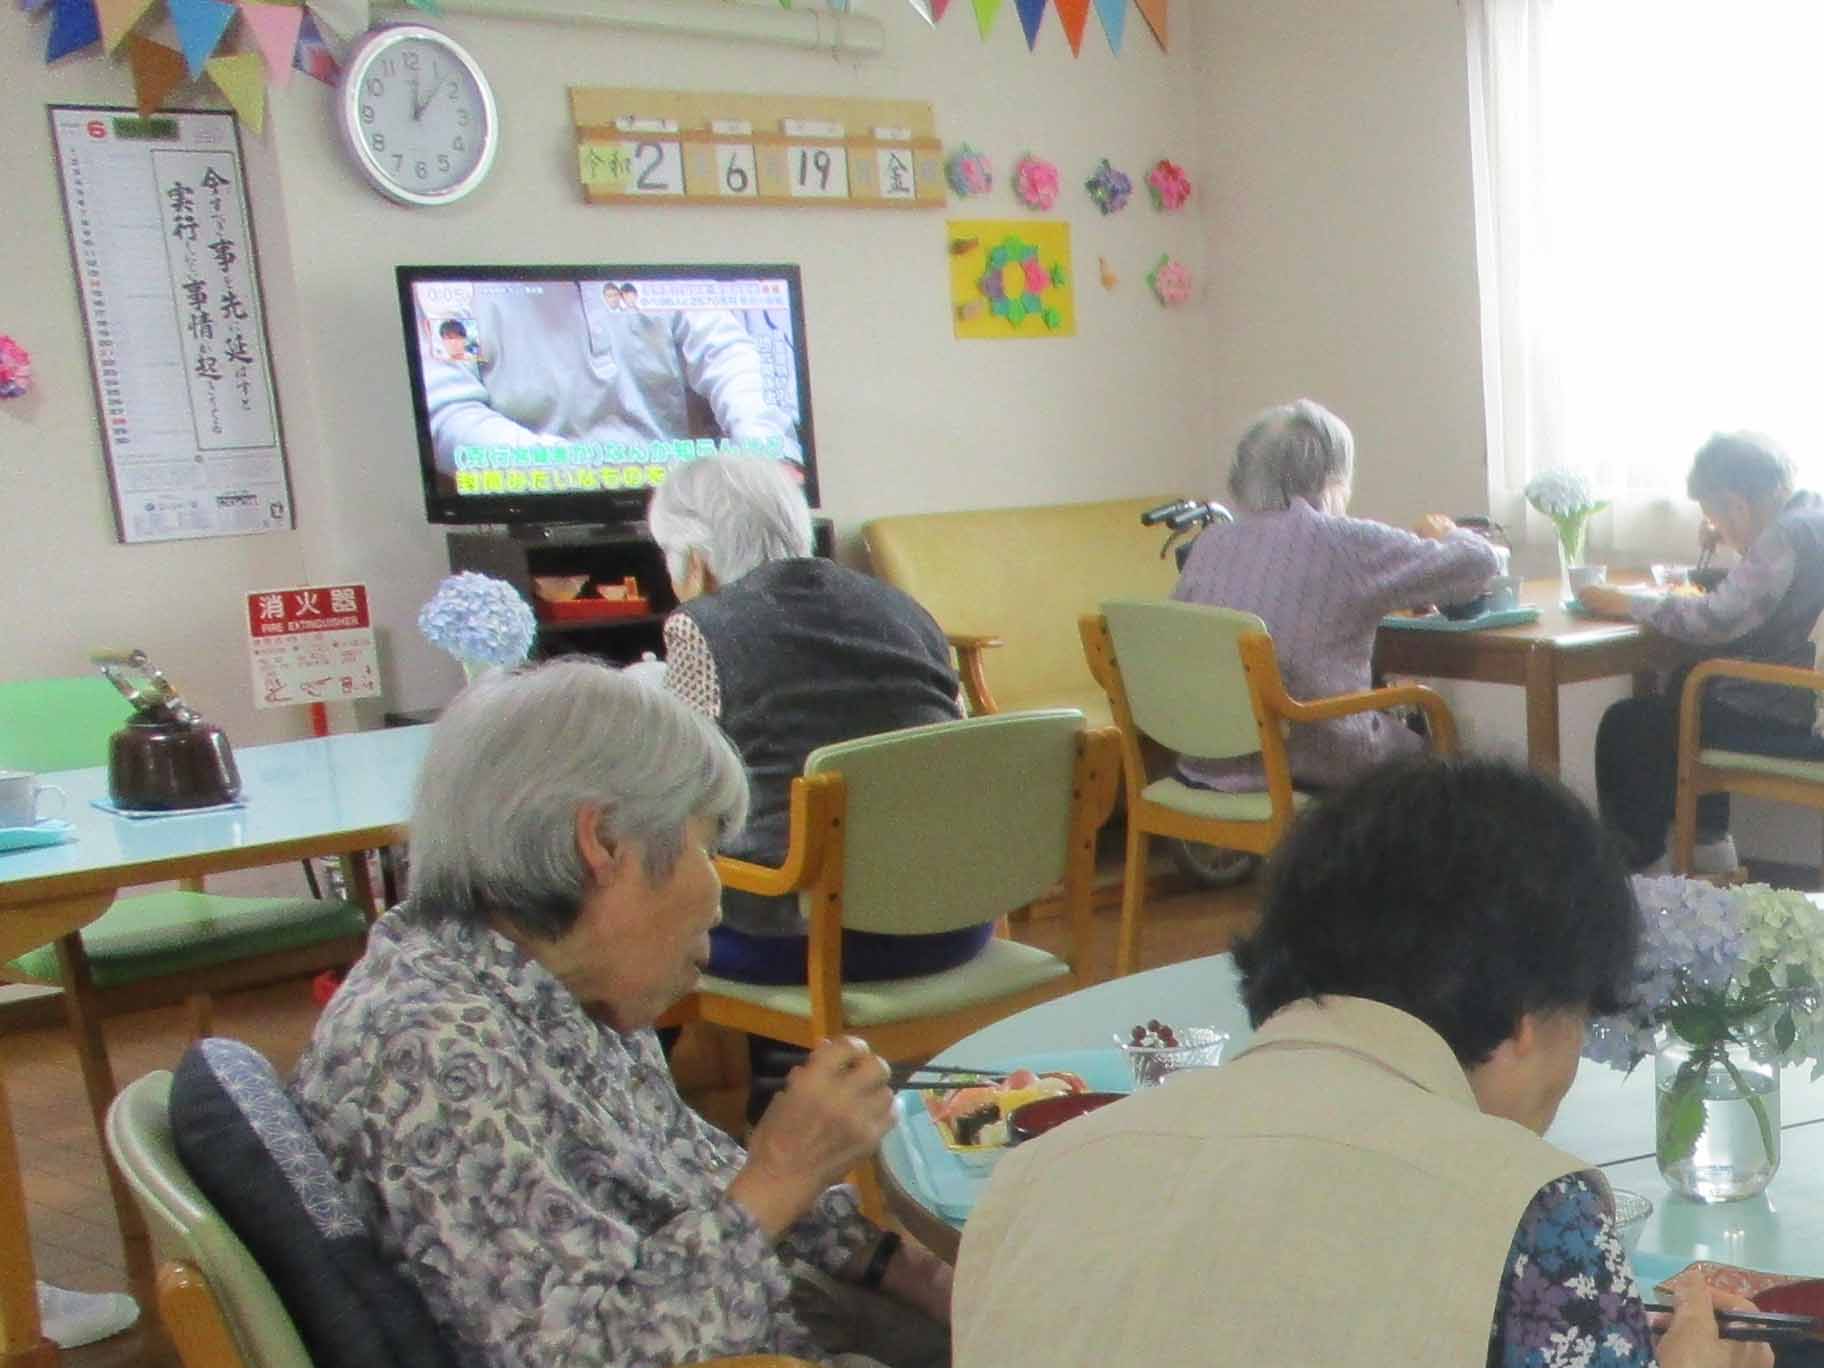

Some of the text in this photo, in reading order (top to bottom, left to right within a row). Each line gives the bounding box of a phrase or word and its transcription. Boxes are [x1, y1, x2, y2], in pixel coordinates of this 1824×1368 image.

[383, 60, 396, 78] 11
[402, 52, 419, 71] 12
[366, 78, 384, 97] 10
[448, 82, 459, 100] 2
[362, 105, 375, 125] 9
[458, 108, 471, 128] 3
[86, 120, 107, 139] 6
[372, 134, 385, 153] 8
[453, 136, 466, 152] 4
[392, 154, 404, 173] 7
[415, 162, 427, 180] 6
[437, 153, 450, 173] 5
[635, 143, 669, 190] 2
[726, 152, 749, 192] 6
[799, 150, 831, 190] 19
[888, 152, 911, 194] 金
[258, 587, 358, 620] 消火器
[260, 622, 285, 633] FIRE
